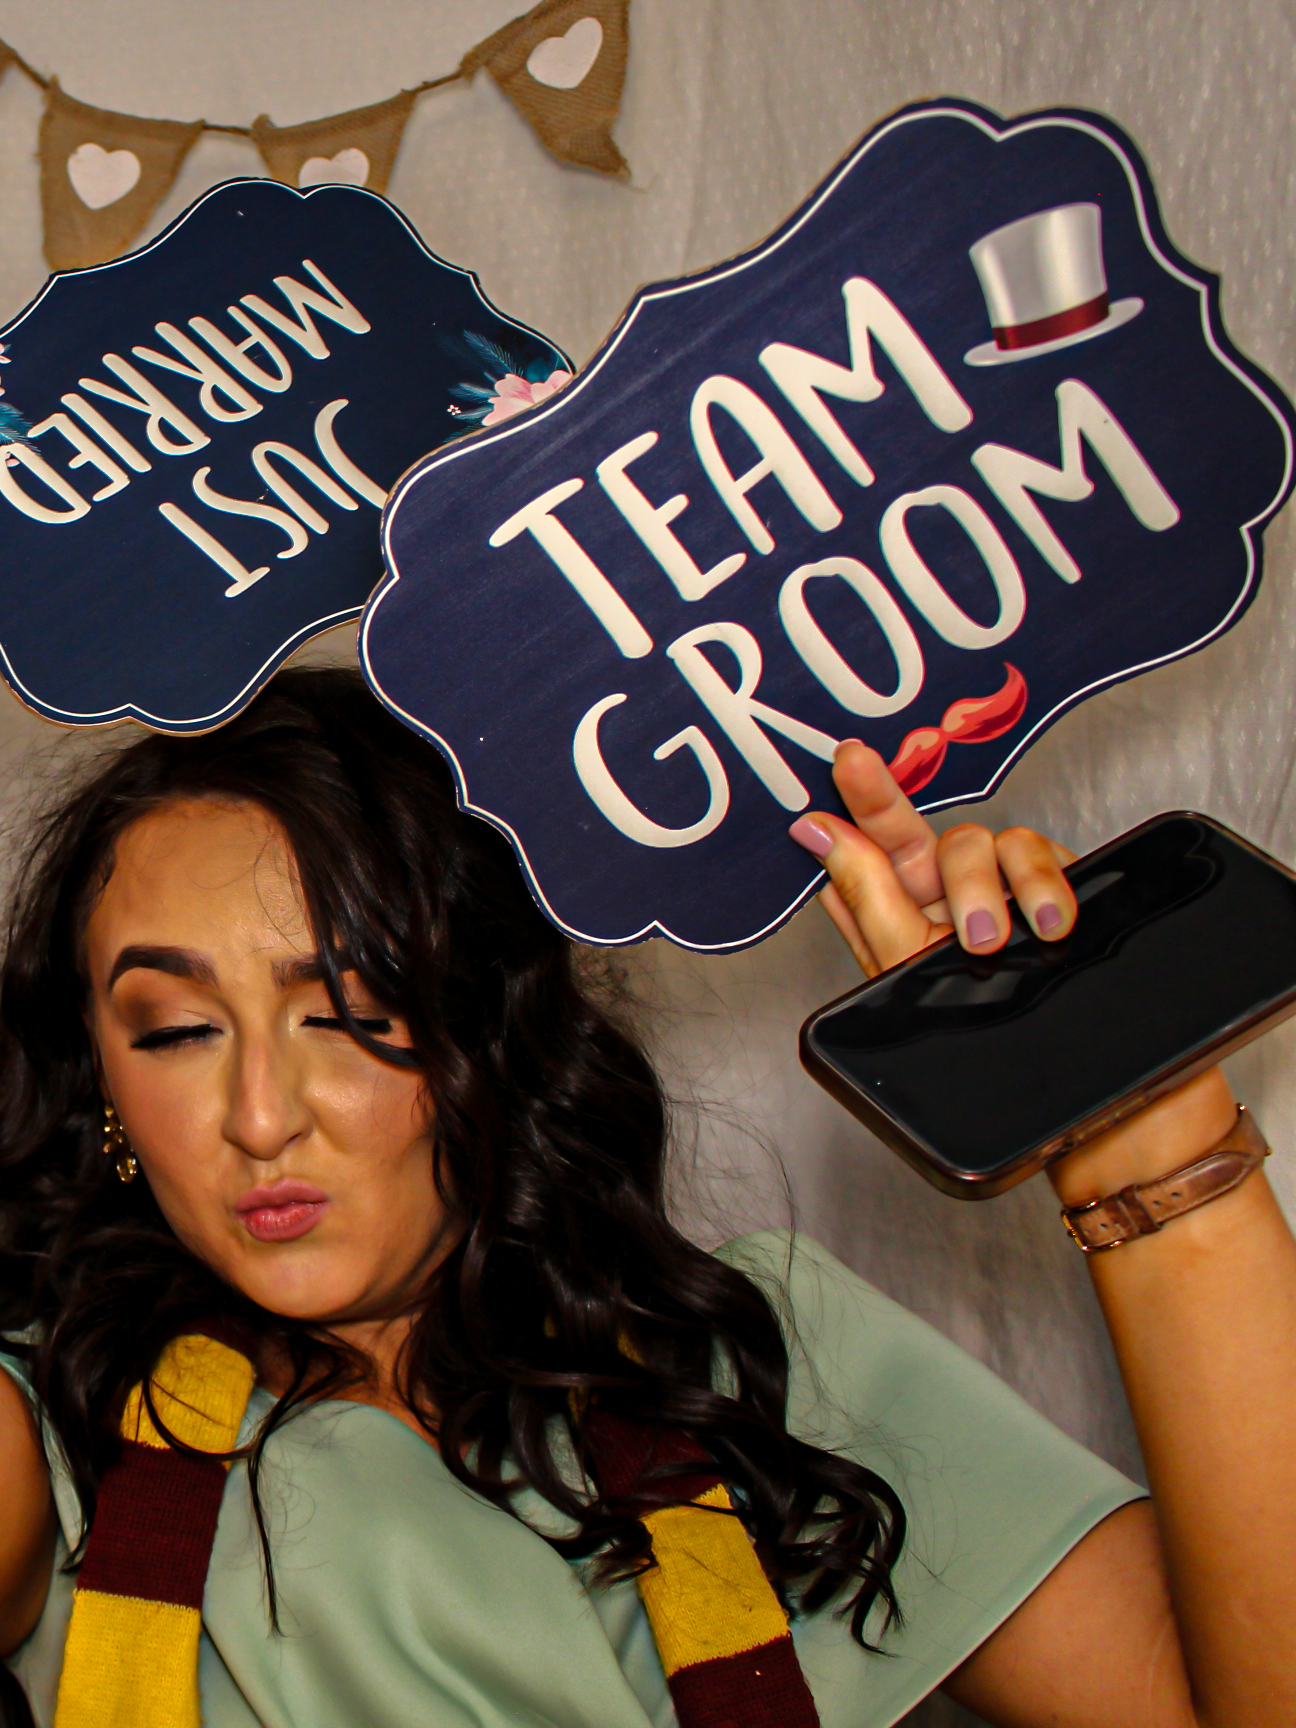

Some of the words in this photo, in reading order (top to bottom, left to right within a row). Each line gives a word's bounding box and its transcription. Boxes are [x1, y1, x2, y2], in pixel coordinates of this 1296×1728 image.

[158, 398, 391, 598] JUST
[489, 276, 974, 658] TEAM
[572, 378, 1181, 848] GROOM
